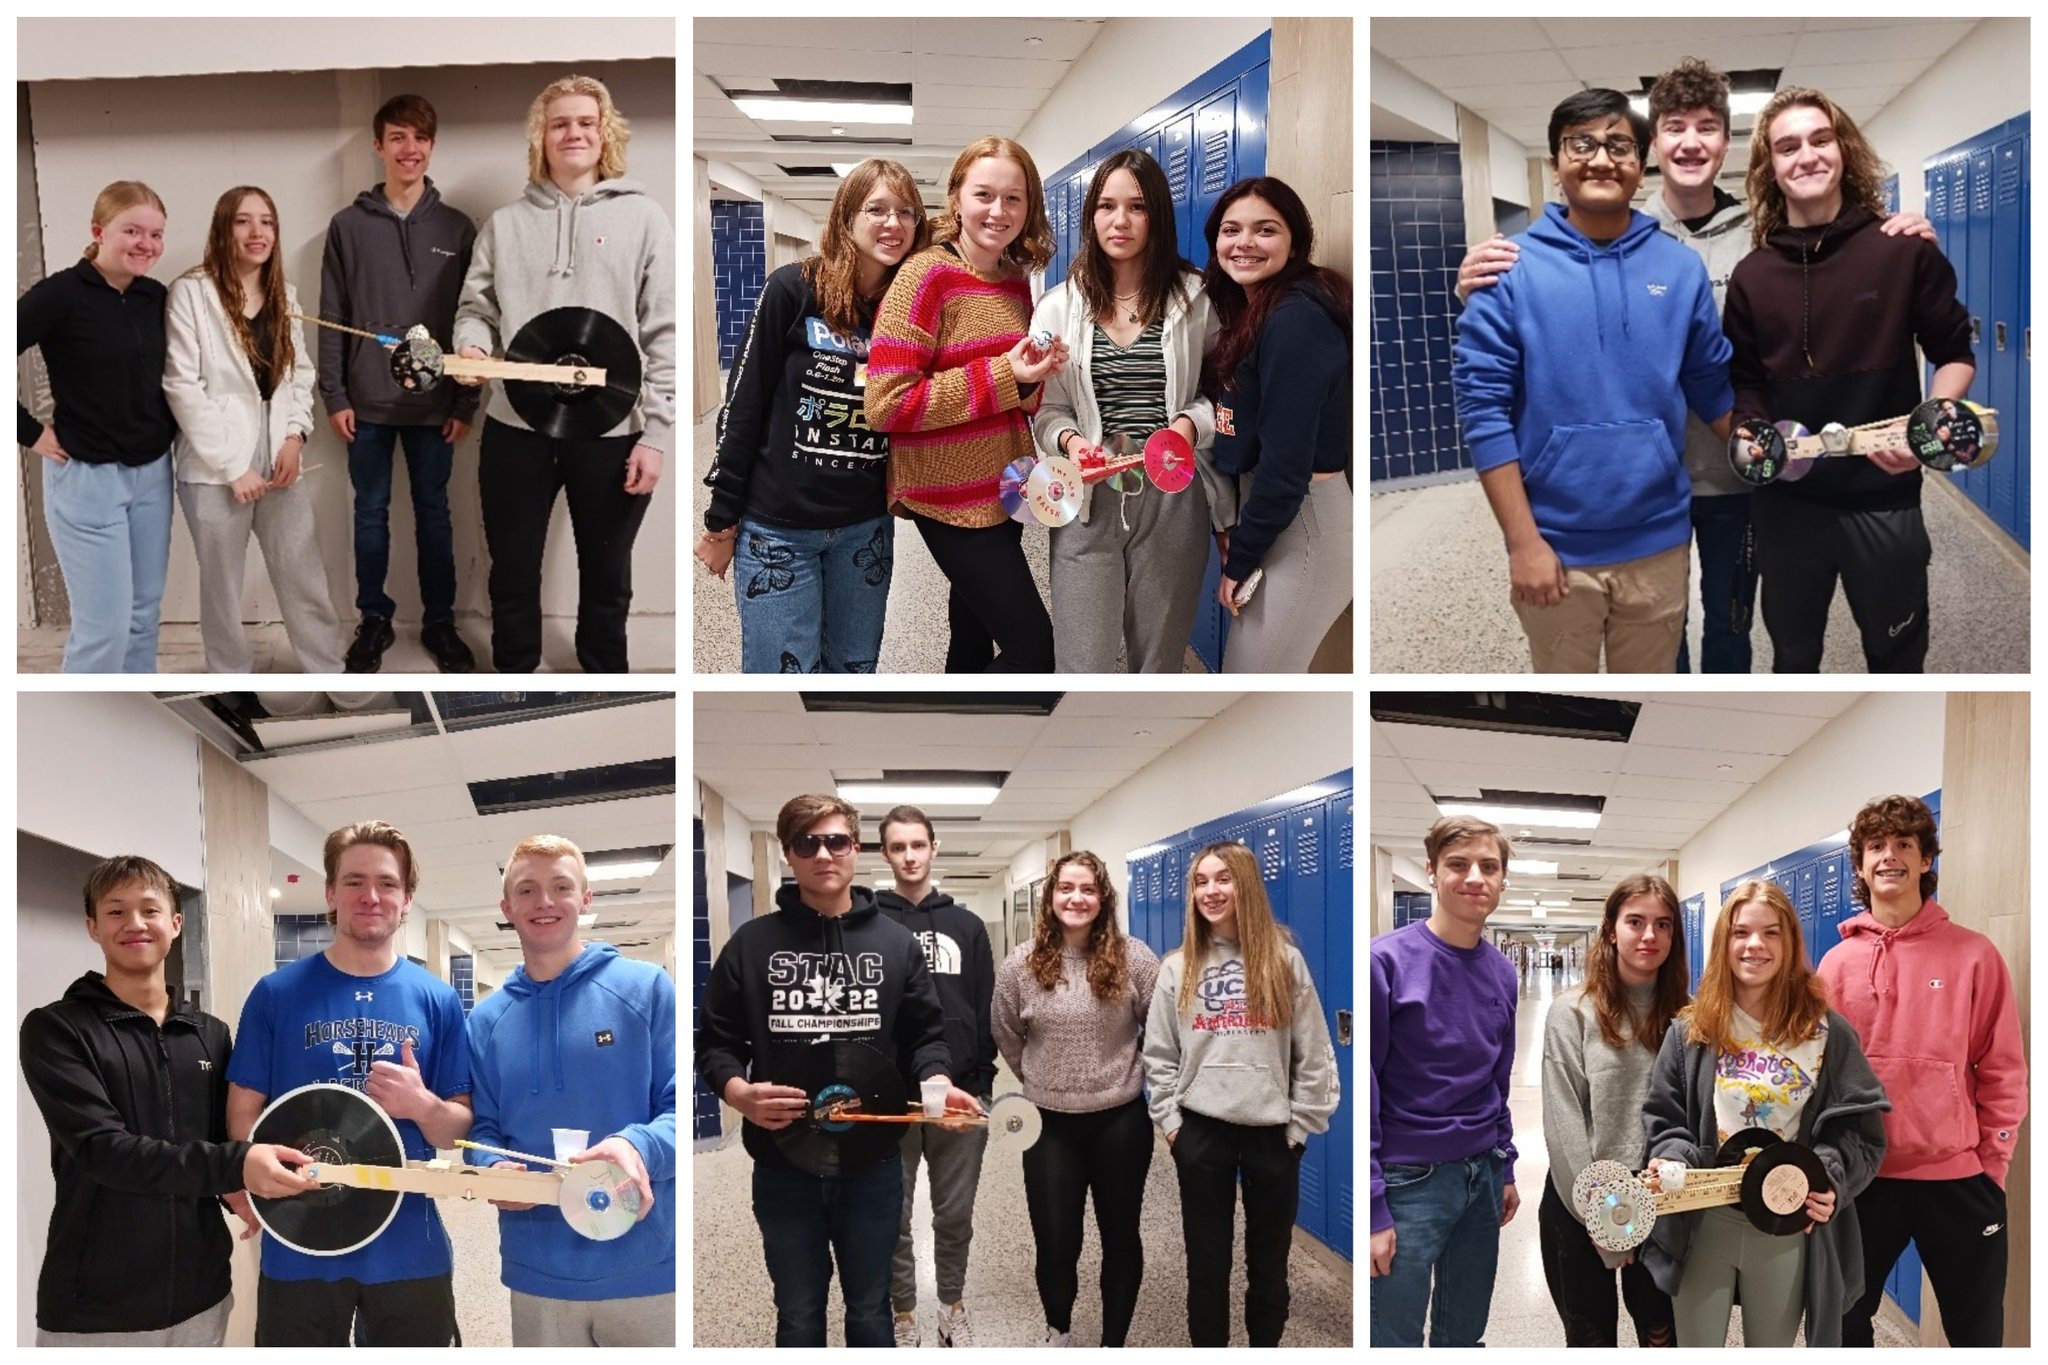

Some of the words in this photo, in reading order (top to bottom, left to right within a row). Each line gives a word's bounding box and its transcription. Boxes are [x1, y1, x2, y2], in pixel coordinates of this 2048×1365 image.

[813, 351, 848, 366] OneStep
[815, 362, 841, 374] Flash
[791, 451, 855, 469] SINCE
[913, 931, 934, 945] HE
[768, 951, 884, 986] STAC
[1204, 978, 1246, 998] UC
[772, 990, 804, 1010] 20
[848, 988, 878, 1010] 22
[771, 1018, 794, 1028] FALL
[797, 1017, 880, 1029] CHAMPIONSHIPS
[304, 1018, 420, 1050] HORSEHEADS
[352, 1042, 376, 1075] H
